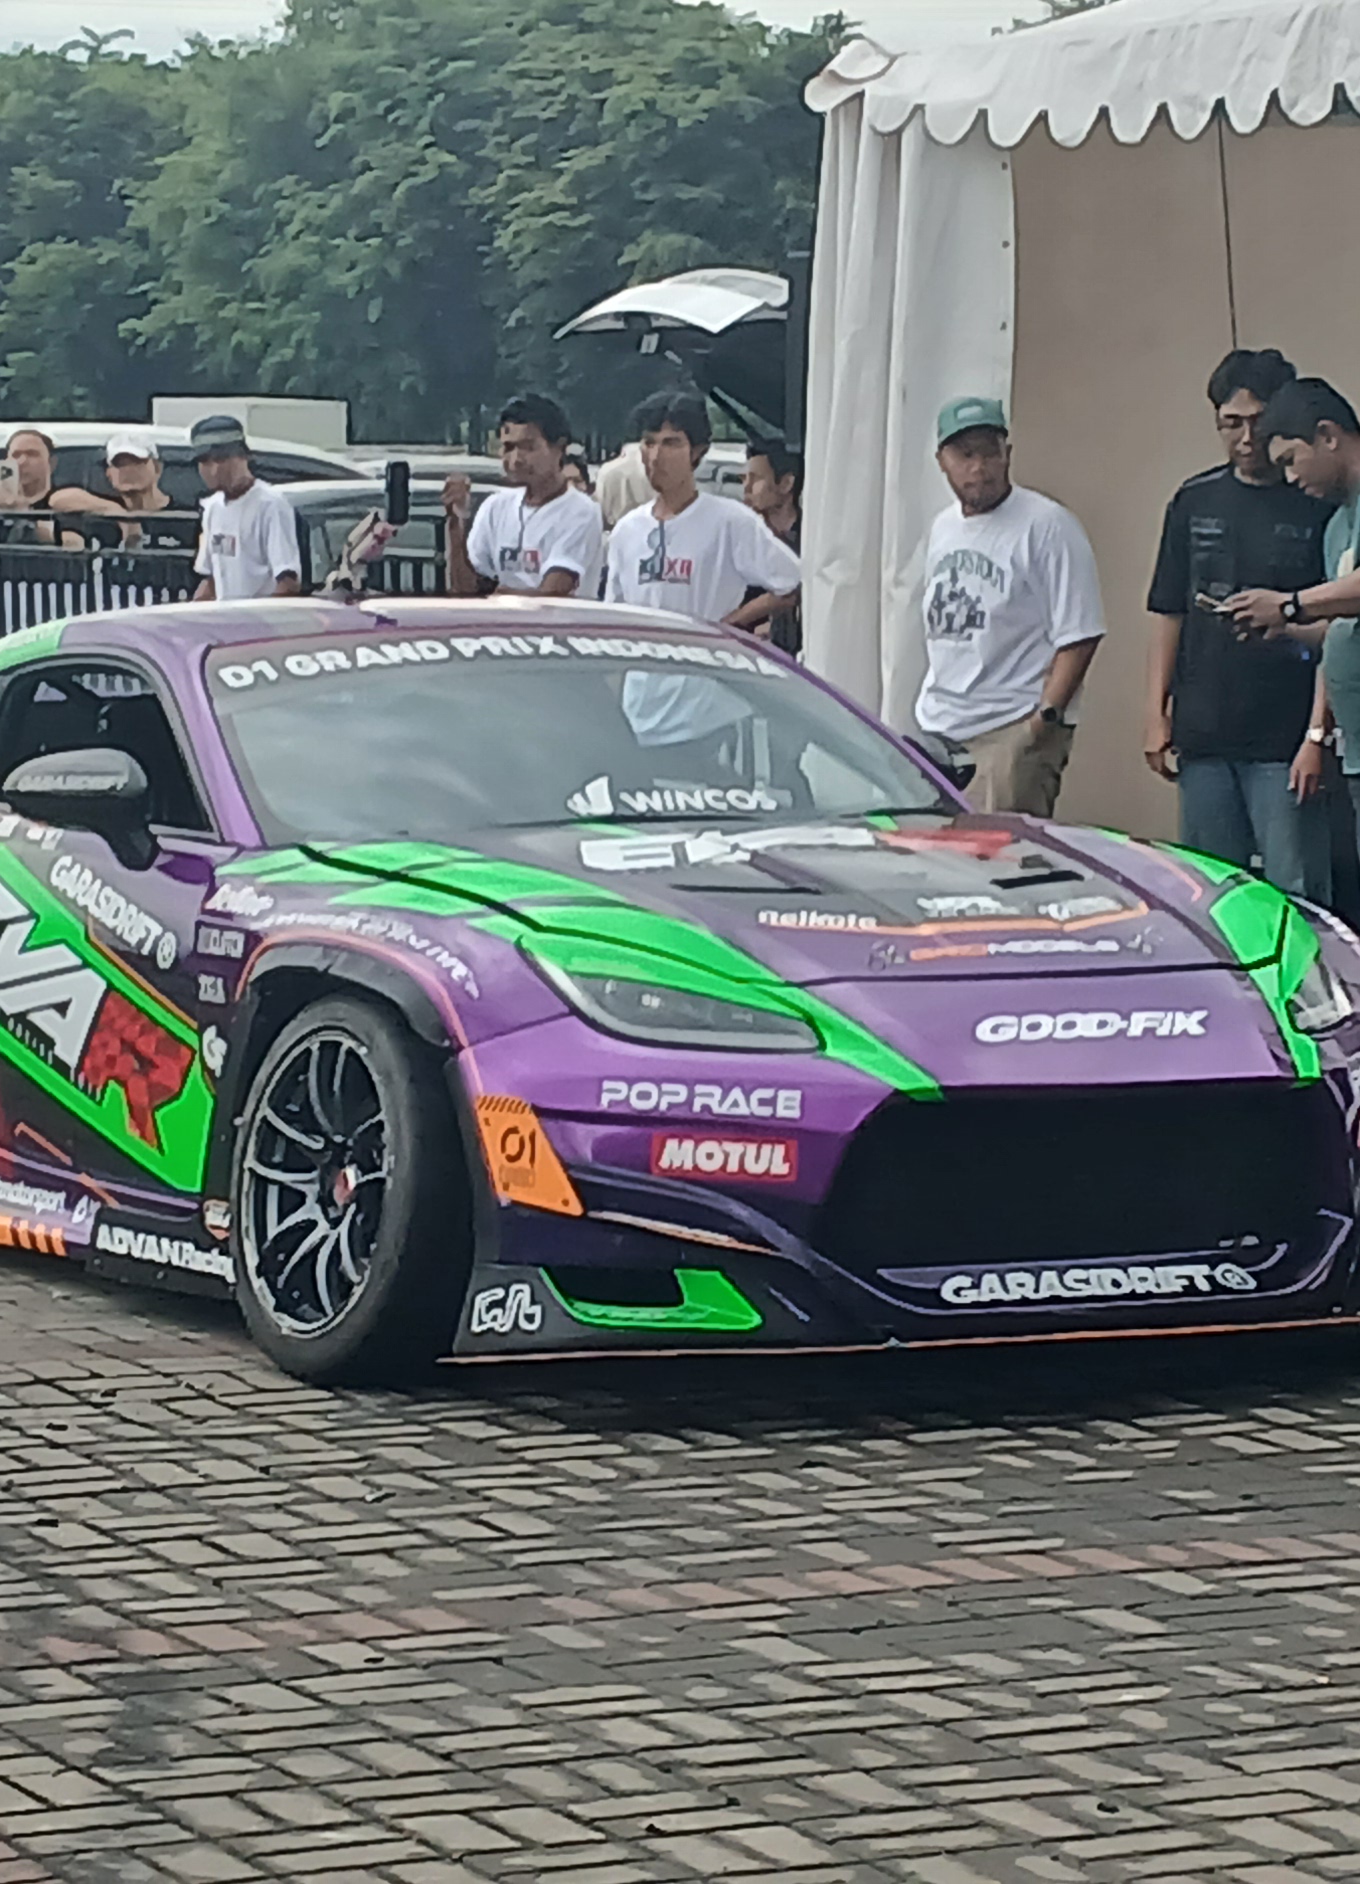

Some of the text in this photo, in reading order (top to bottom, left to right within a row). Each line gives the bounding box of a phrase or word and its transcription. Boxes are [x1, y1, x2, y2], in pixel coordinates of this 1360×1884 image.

[218, 660, 279, 689] D1
[285, 640, 450, 677] GRAND
[450, 636, 570, 658] PRIX
[601, 1080, 802, 1119] POP RACE
[659, 1138, 790, 1175] MOTUL
[940, 1264, 1212, 1304] GARASIDRIFT
